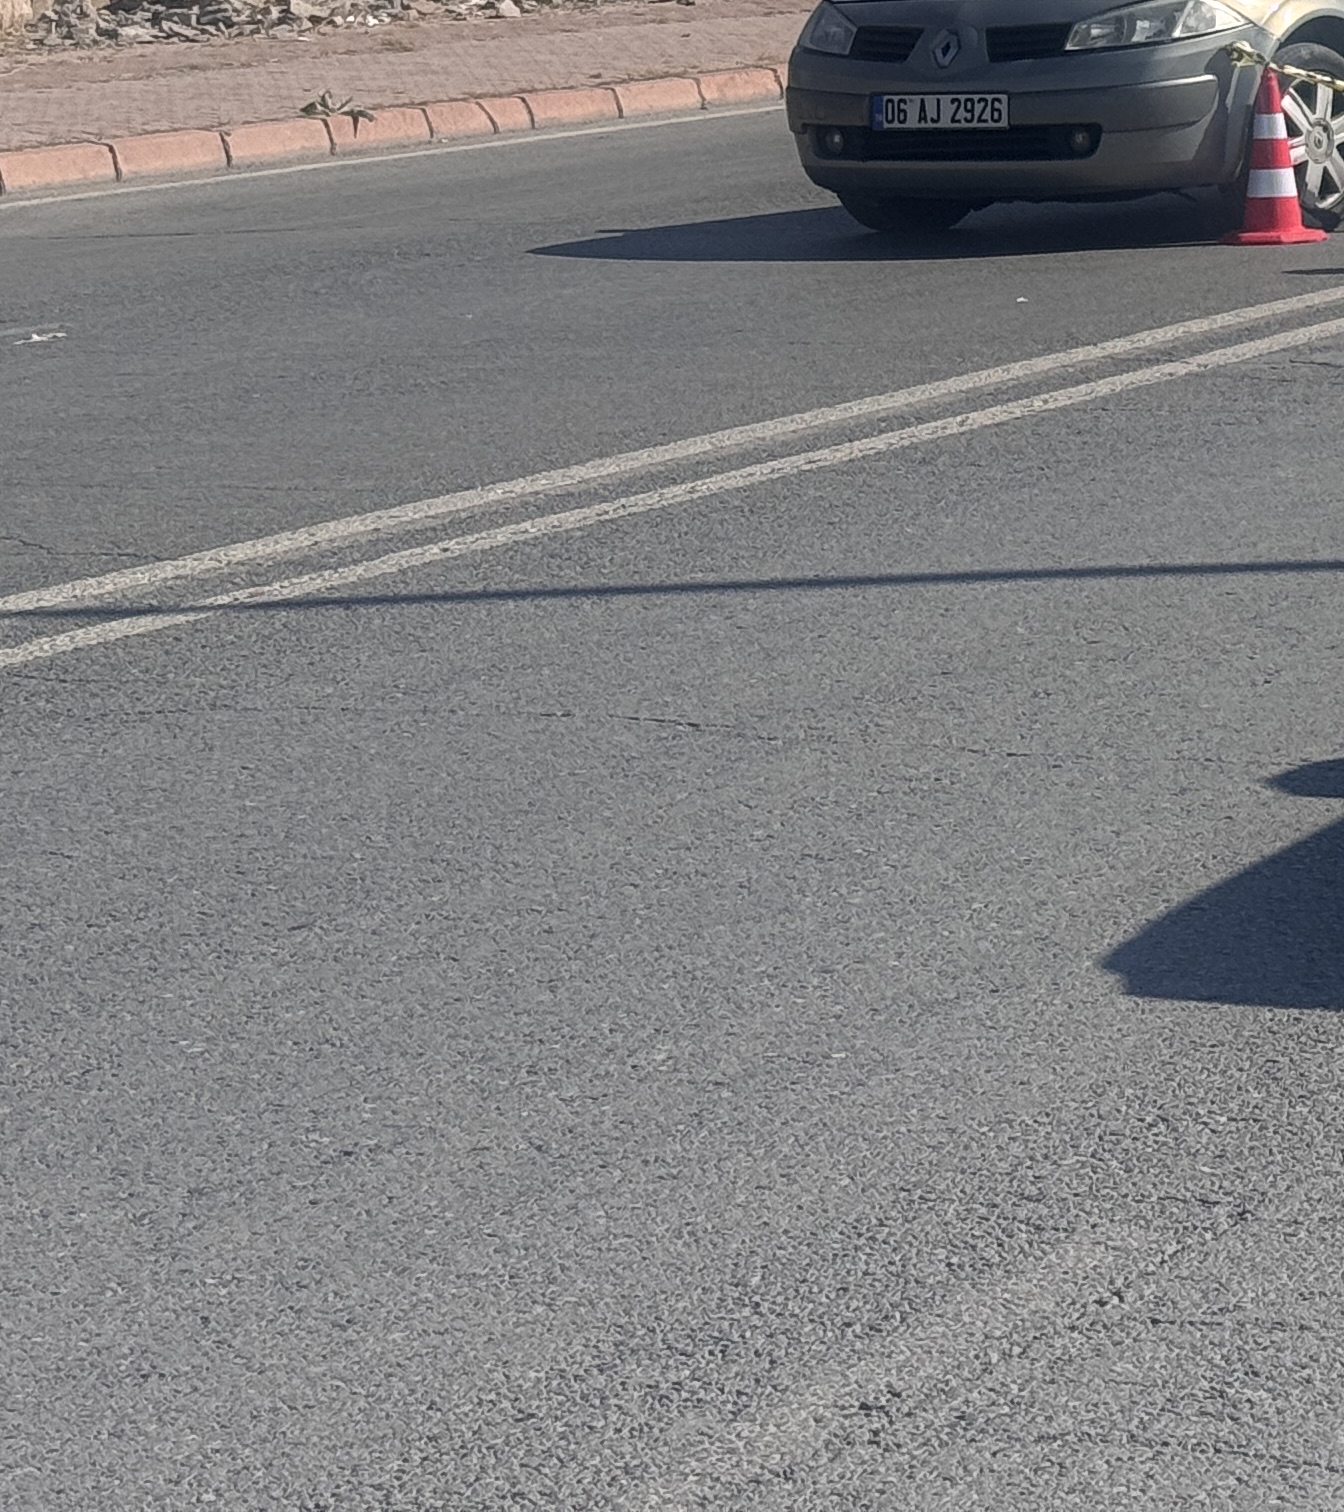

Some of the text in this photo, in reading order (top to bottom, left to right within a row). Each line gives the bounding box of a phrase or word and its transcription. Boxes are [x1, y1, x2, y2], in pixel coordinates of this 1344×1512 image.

[884, 97, 1003, 125] 06 AJ 2926
